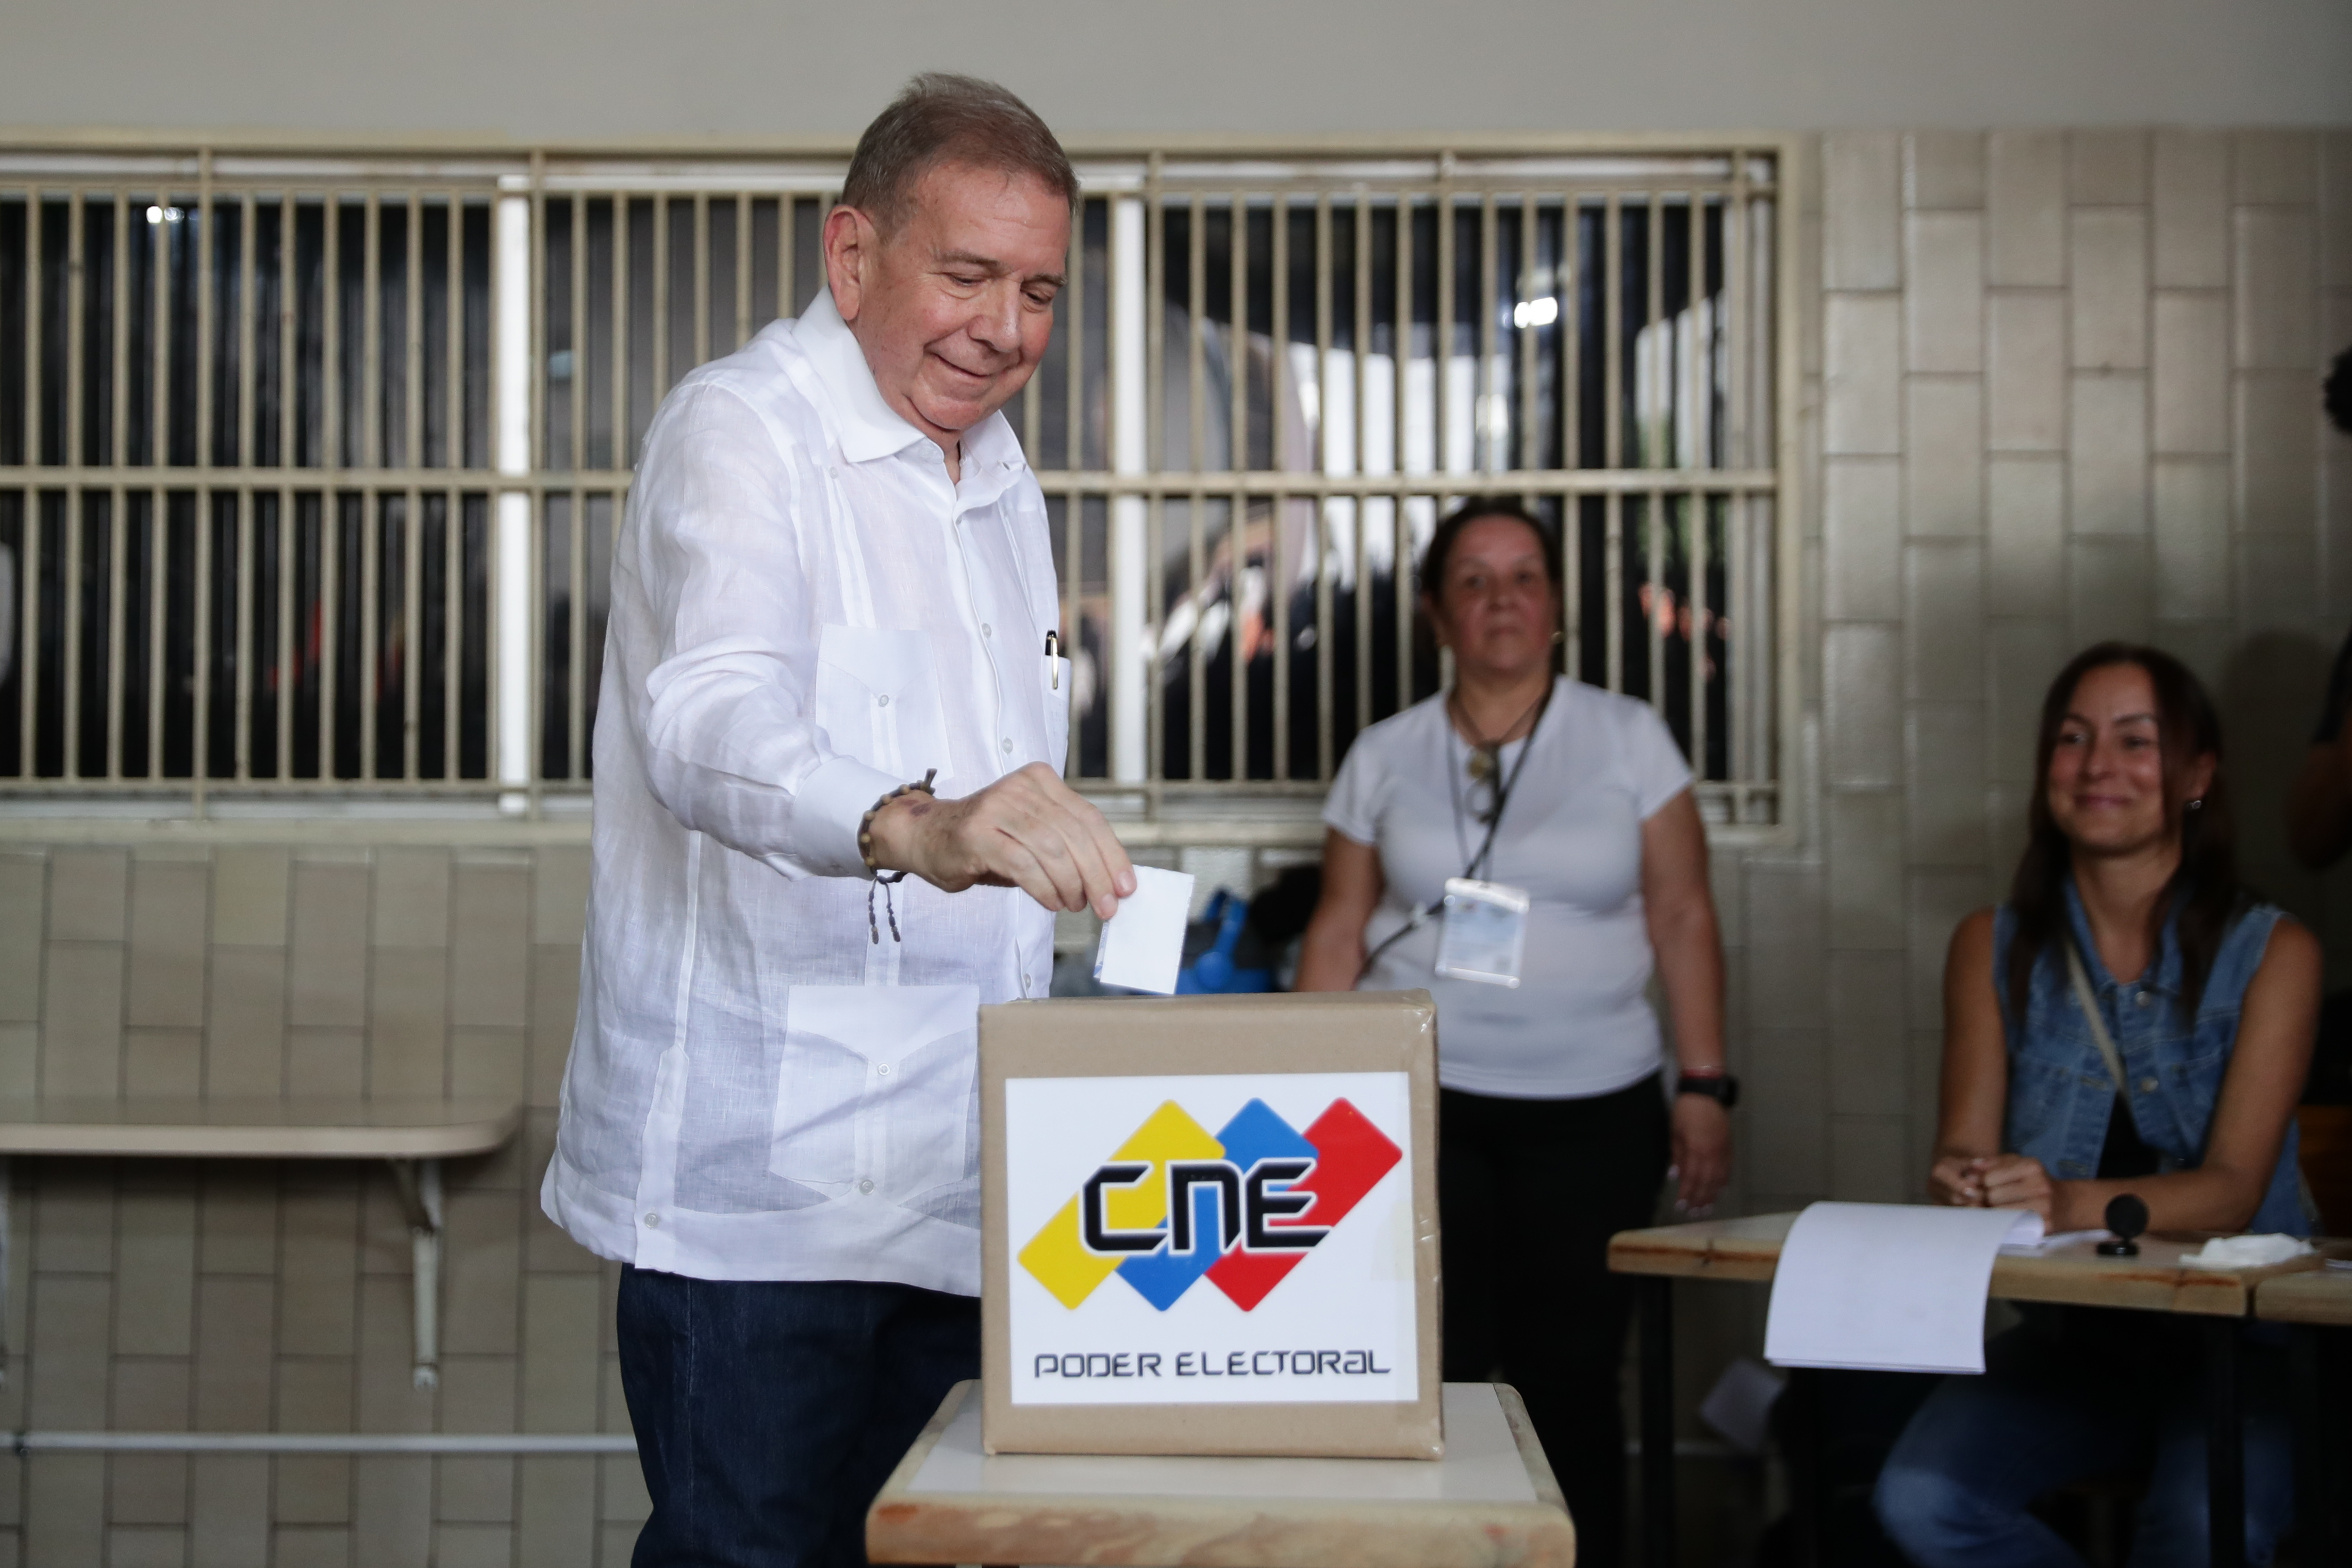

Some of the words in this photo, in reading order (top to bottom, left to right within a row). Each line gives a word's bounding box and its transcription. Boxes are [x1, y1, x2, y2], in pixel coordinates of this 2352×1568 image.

[1082, 1162, 1331, 1251] CNE
[1034, 1353, 1162, 1378] PODER
[1175, 1349, 1391, 1376] ELECTORAL
